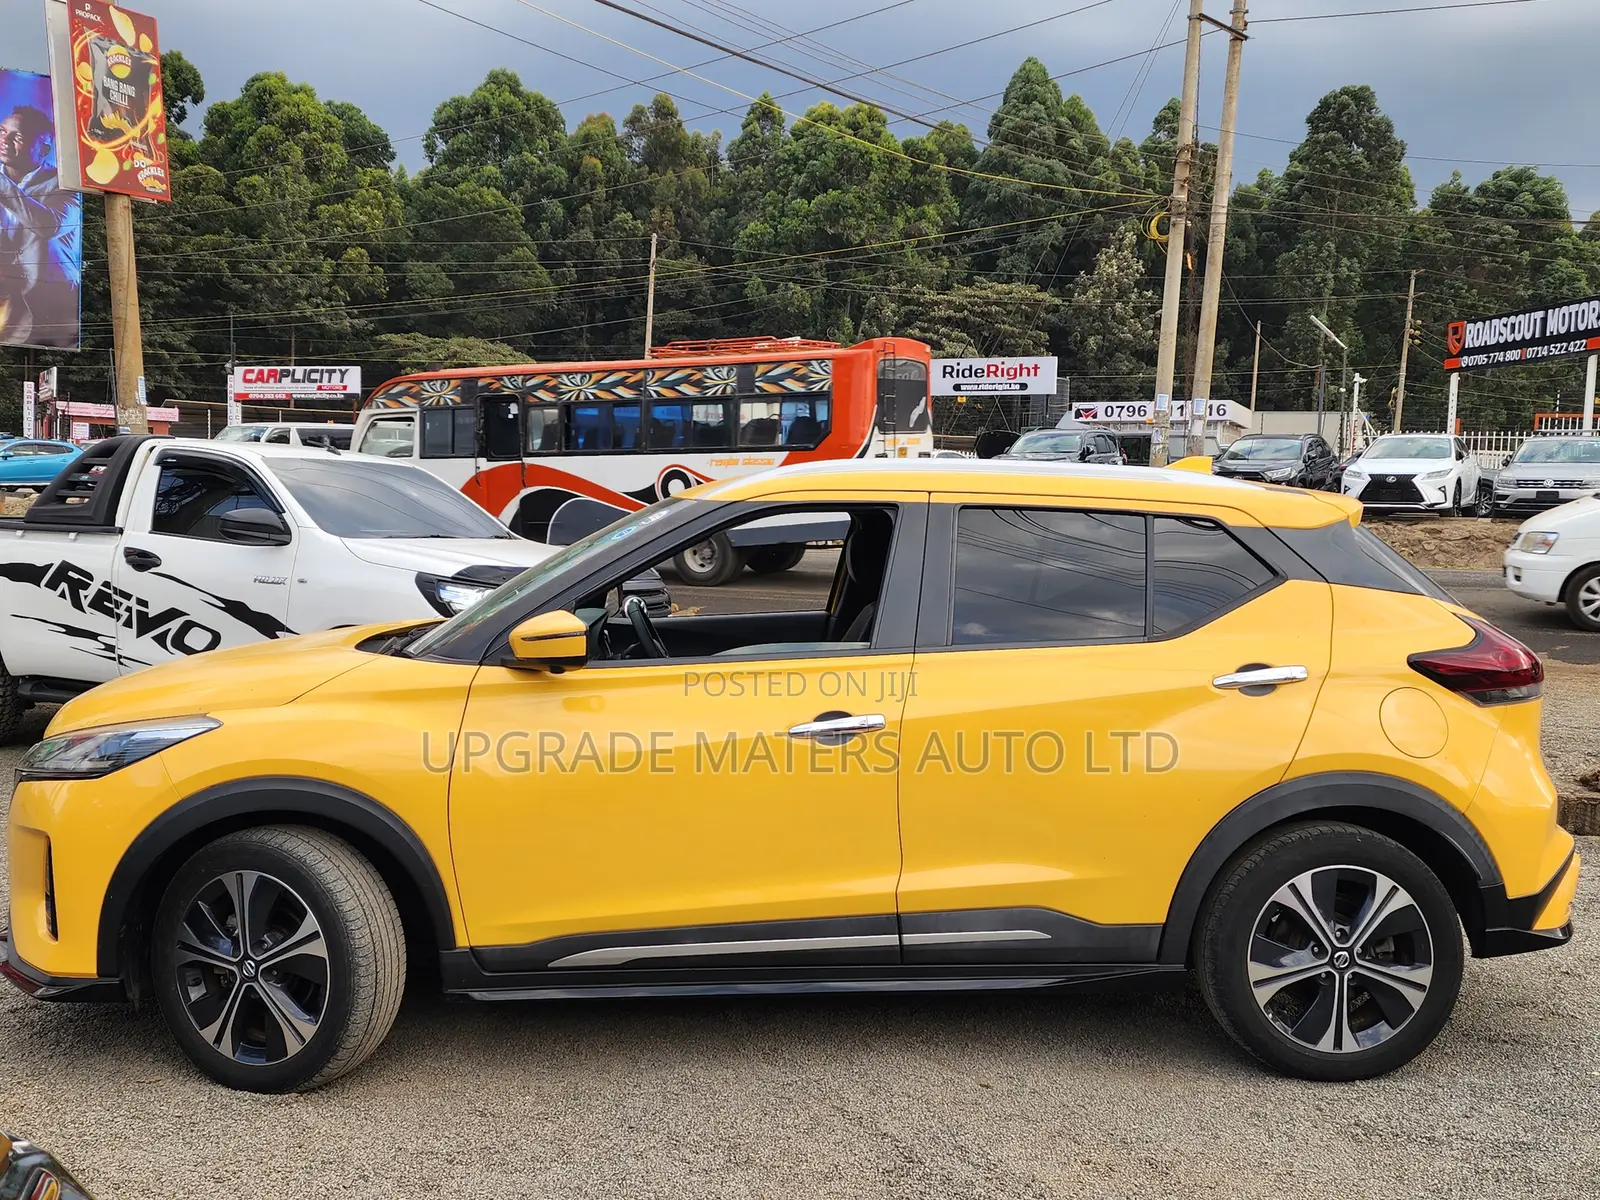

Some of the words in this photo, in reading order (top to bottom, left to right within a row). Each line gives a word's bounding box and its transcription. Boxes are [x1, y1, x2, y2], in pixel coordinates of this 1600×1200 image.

[75, 8, 103, 23] PROPACK
[107, 54, 132, 67] KRACKLES
[103, 75, 119, 94] BANG
[119, 82, 136, 98] BANG
[109, 89, 129, 107] CHILLI
[134, 159, 147, 169] DO
[137, 166, 165, 183] KRACKLES
[1465, 310, 1546, 349] ROADSCOUT
[1468, 354, 1487, 367] 0705
[1488, 352, 1504, 364] 774
[1505, 349, 1521, 361] 800
[1526, 345, 1548, 359] 0714
[1550, 342, 1567, 355] 522
[1568, 339, 1587, 353] 422
[242, 368, 349, 384] CARPLICITY
[942, 361, 1041, 380] RideRight
[1104, 404, 1148, 418] 0796
[1207, 403, 1227, 417] 16
[44, 560, 222, 656] REVO
